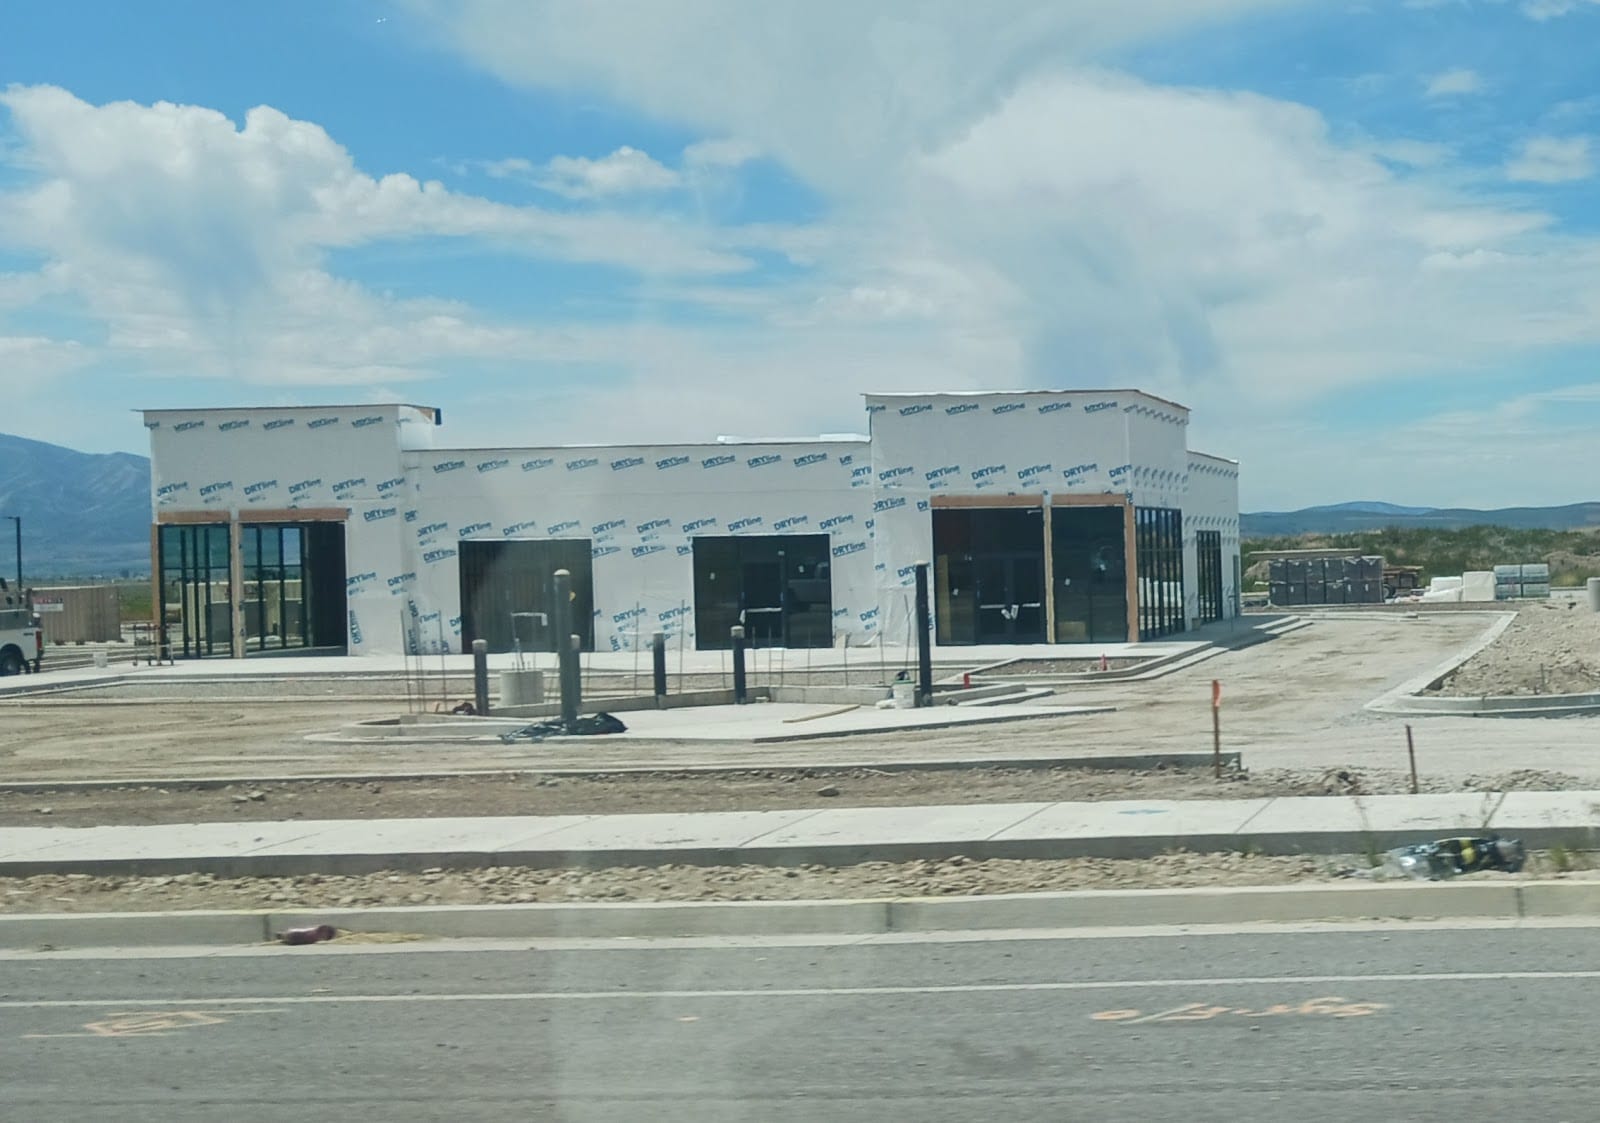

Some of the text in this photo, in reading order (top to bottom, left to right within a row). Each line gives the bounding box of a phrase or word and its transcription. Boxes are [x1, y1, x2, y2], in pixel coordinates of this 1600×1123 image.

[879, 466, 914, 480] DRYline
[925, 465, 960, 480] DRYline
[971, 464, 1006, 480] DRYline
[1017, 464, 1052, 479] DRYline
[1063, 463, 1097, 478] DRYline
[200, 480, 232, 496] DRYline
[244, 480, 277, 495] DRYline
[288, 479, 321, 494] DRYline
[332, 478, 365, 493] DRYline
[459, 522, 492, 537] DRYline
[503, 521, 535, 536] DRYline
[592, 519, 625, 534] DRYline
[637, 518, 671, 533] DRYline
[682, 517, 716, 533] DRYline
[728, 516, 762, 532] DRYline
[774, 515, 808, 530] DRYline
[820, 514, 854, 530] DRYline
[832, 542, 866, 557] DRYline
